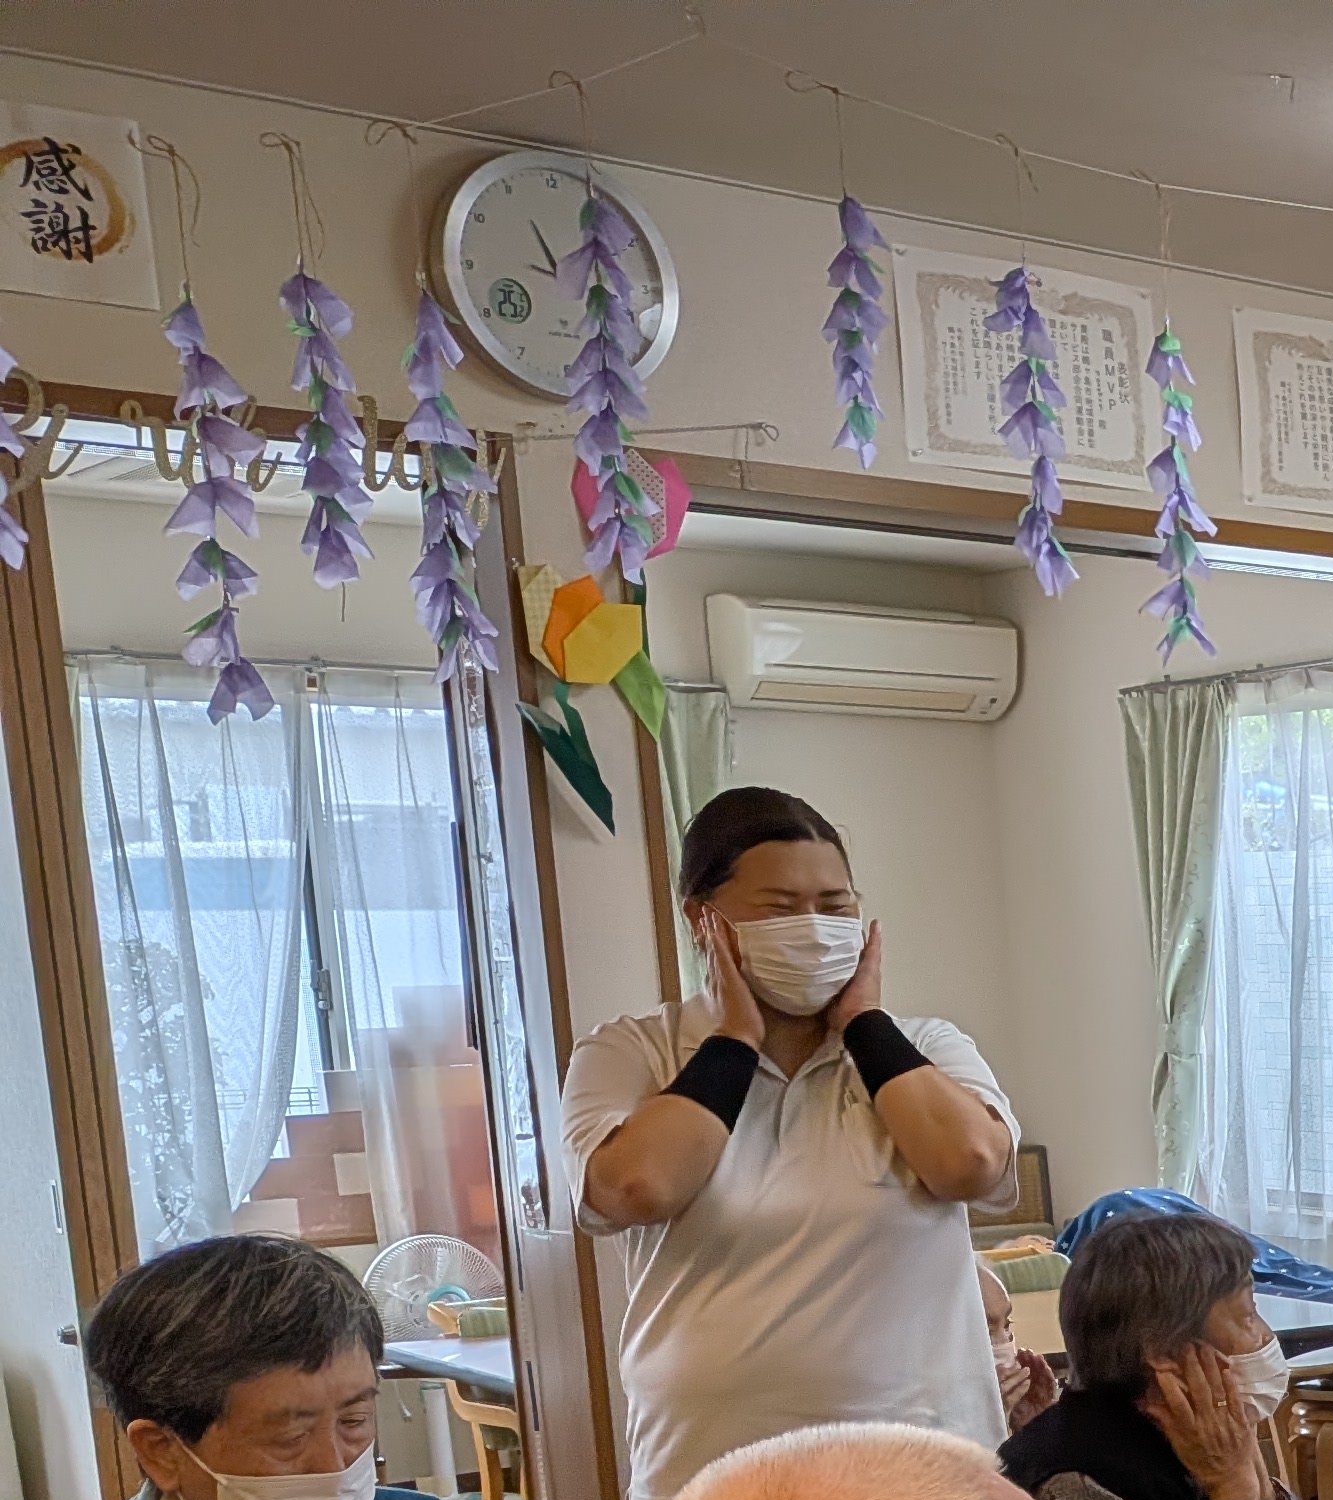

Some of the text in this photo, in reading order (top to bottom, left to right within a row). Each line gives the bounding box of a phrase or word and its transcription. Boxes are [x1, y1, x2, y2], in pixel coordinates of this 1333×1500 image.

[19, 136, 94, 264] 感謝
[464, 259, 474, 270] 9
[482, 307, 492, 319] 8
